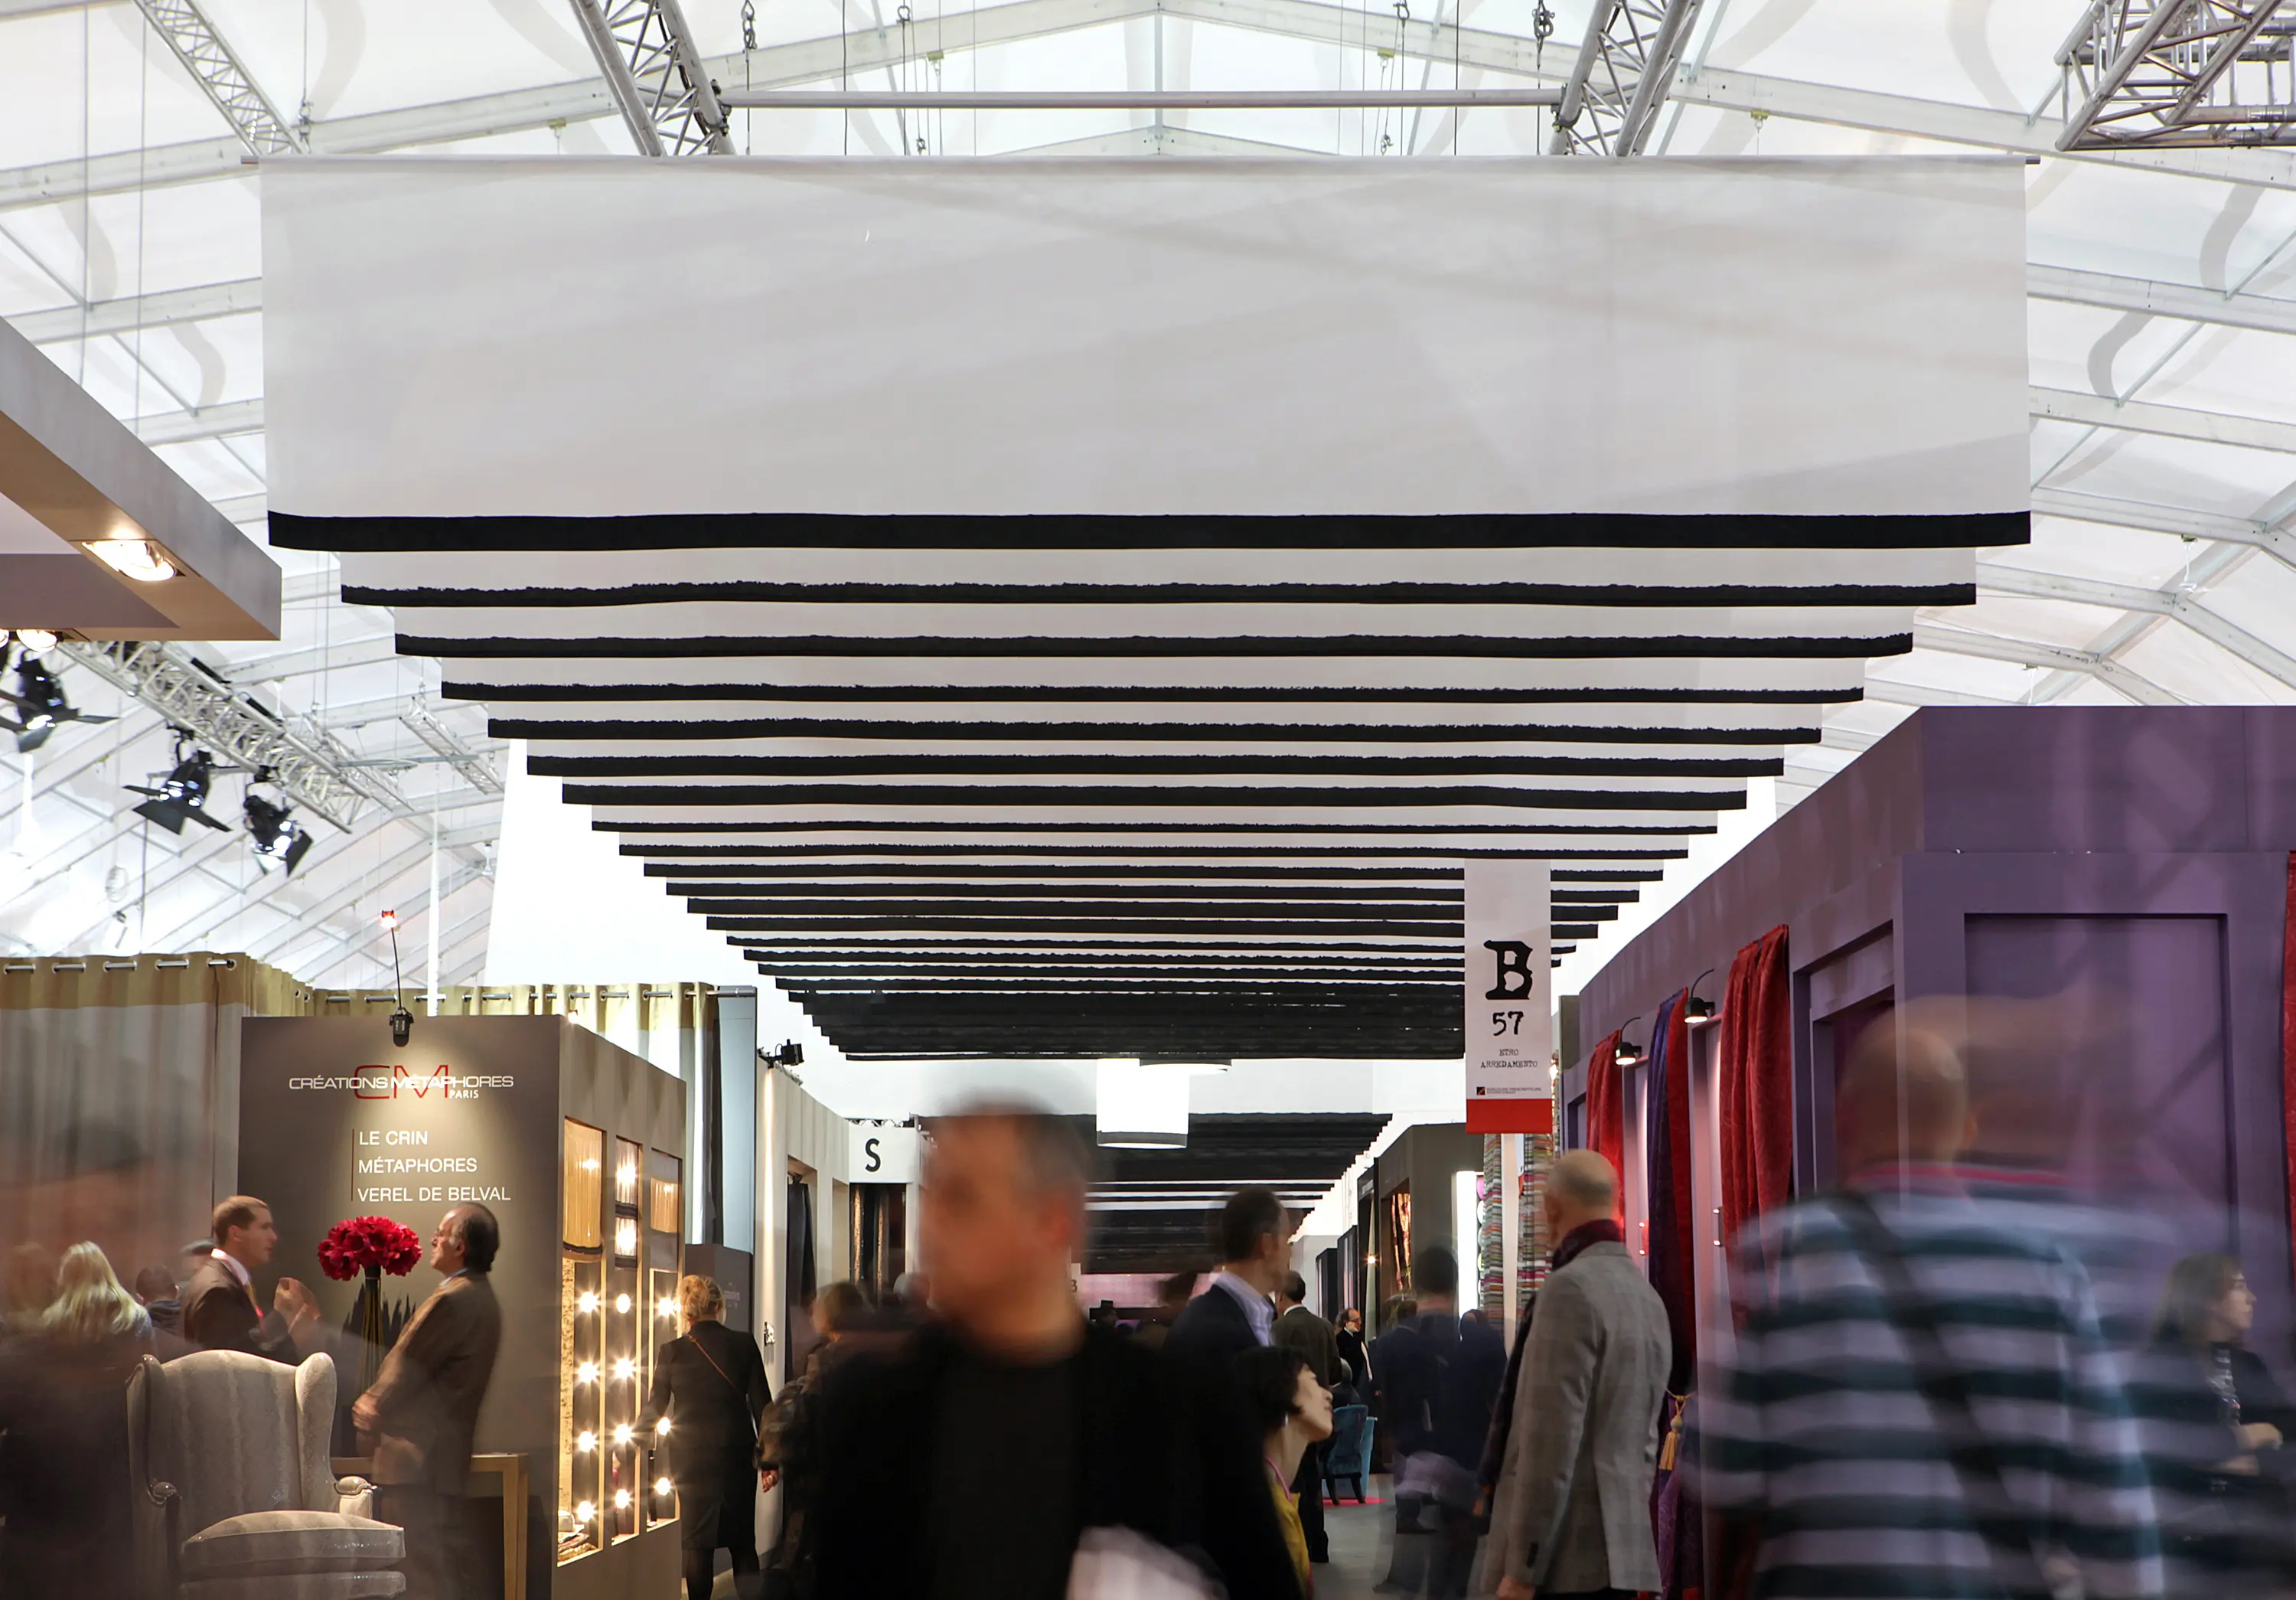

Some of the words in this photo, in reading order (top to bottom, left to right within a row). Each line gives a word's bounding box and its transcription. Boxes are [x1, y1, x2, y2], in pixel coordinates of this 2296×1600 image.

[1483, 939, 1533, 1001] B
[1492, 1011, 1524, 1037] 57
[1499, 1048, 1519, 1056] ETRO
[1480, 1060, 1538, 1069] ARREDAMENTO
[289, 1074, 388, 1090] CRÉATIONS
[391, 1073, 514, 1090] MÉTAPHORES
[449, 1089, 479, 1099] PARIS
[359, 1131, 380, 1145] LE
[385, 1130, 429, 1145] CRIN
[865, 1138, 881, 1172] S
[358, 1156, 478, 1174] MÉTAPHORES
[357, 1187, 413, 1202] VEREL
[419, 1187, 442, 1201] DE
[448, 1187, 511, 1201] BELVAL
